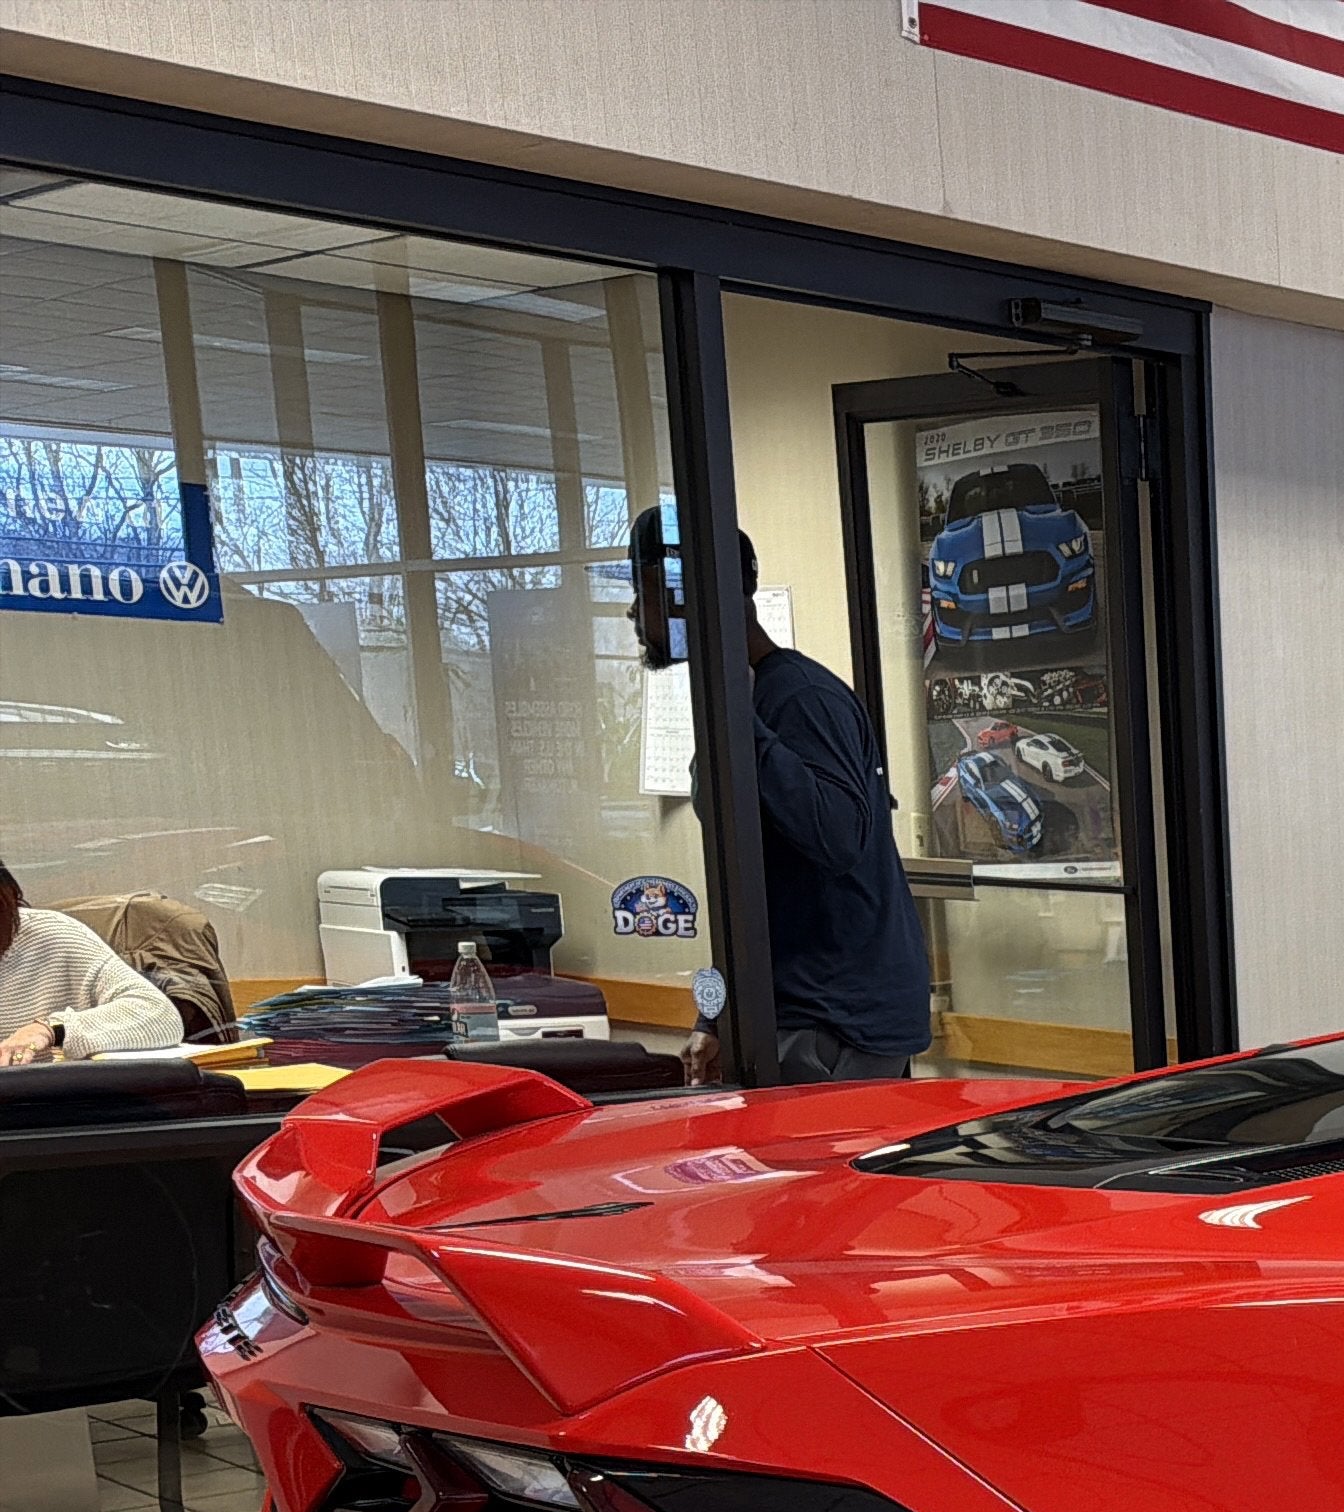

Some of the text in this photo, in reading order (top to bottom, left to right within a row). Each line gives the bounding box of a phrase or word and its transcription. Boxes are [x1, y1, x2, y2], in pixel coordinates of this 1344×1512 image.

[923, 419, 1093, 462] SHELBY GT 350
[614, 909, 696, 937] DOGE
